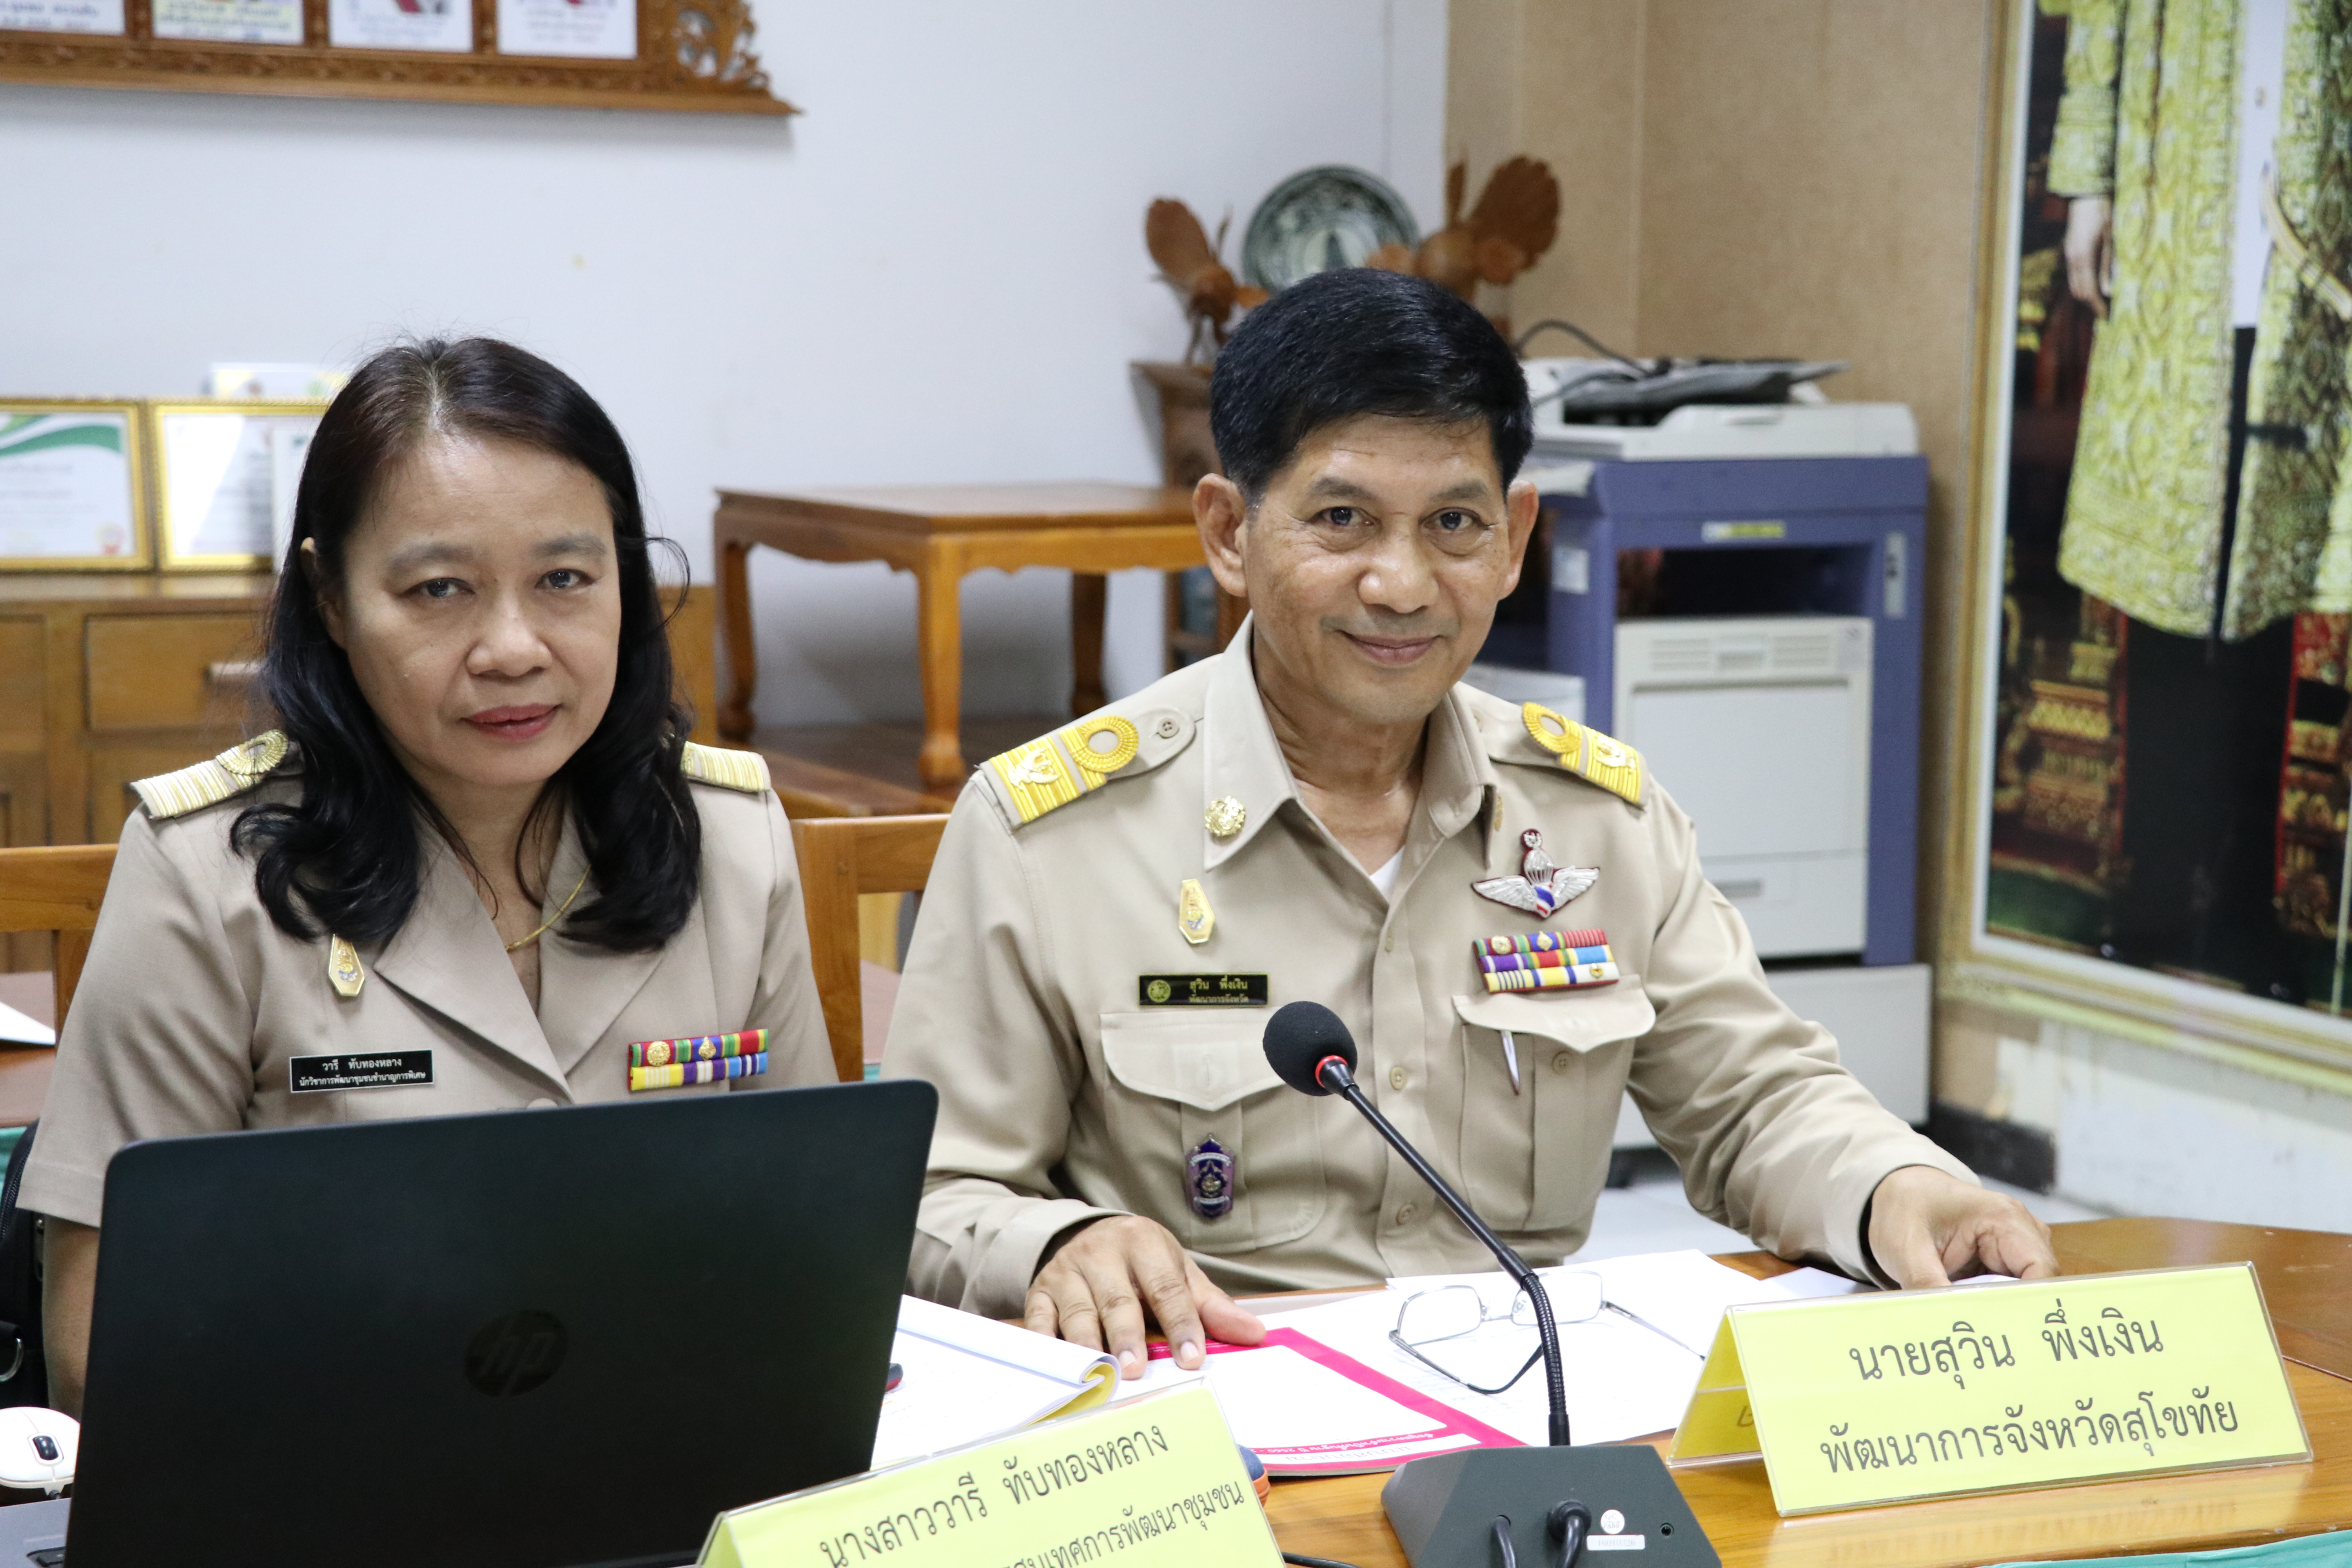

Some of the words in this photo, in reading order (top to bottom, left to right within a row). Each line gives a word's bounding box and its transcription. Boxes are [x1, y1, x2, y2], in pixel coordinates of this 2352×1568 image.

[321, 1058, 339, 1071] วารี
[348, 1057, 403, 1070] ทับทองหลาง
[1847, 1320, 2016, 1390] นายสุวิน
[2041, 1298, 2164, 1362] พึ่งเงิน
[1285, 1446, 1412, 1461] แบบสอบถาม
[1819, 1386, 2239, 1474] พัฒนาการจังหวัดสุโขทัย
[820, 1472, 988, 1568] นางสาววารี
[1002, 1422, 1169, 1505] ทับทองหลาง
[1001, 1481, 1245, 1568] นเทศการพัฒนาชุมชน
